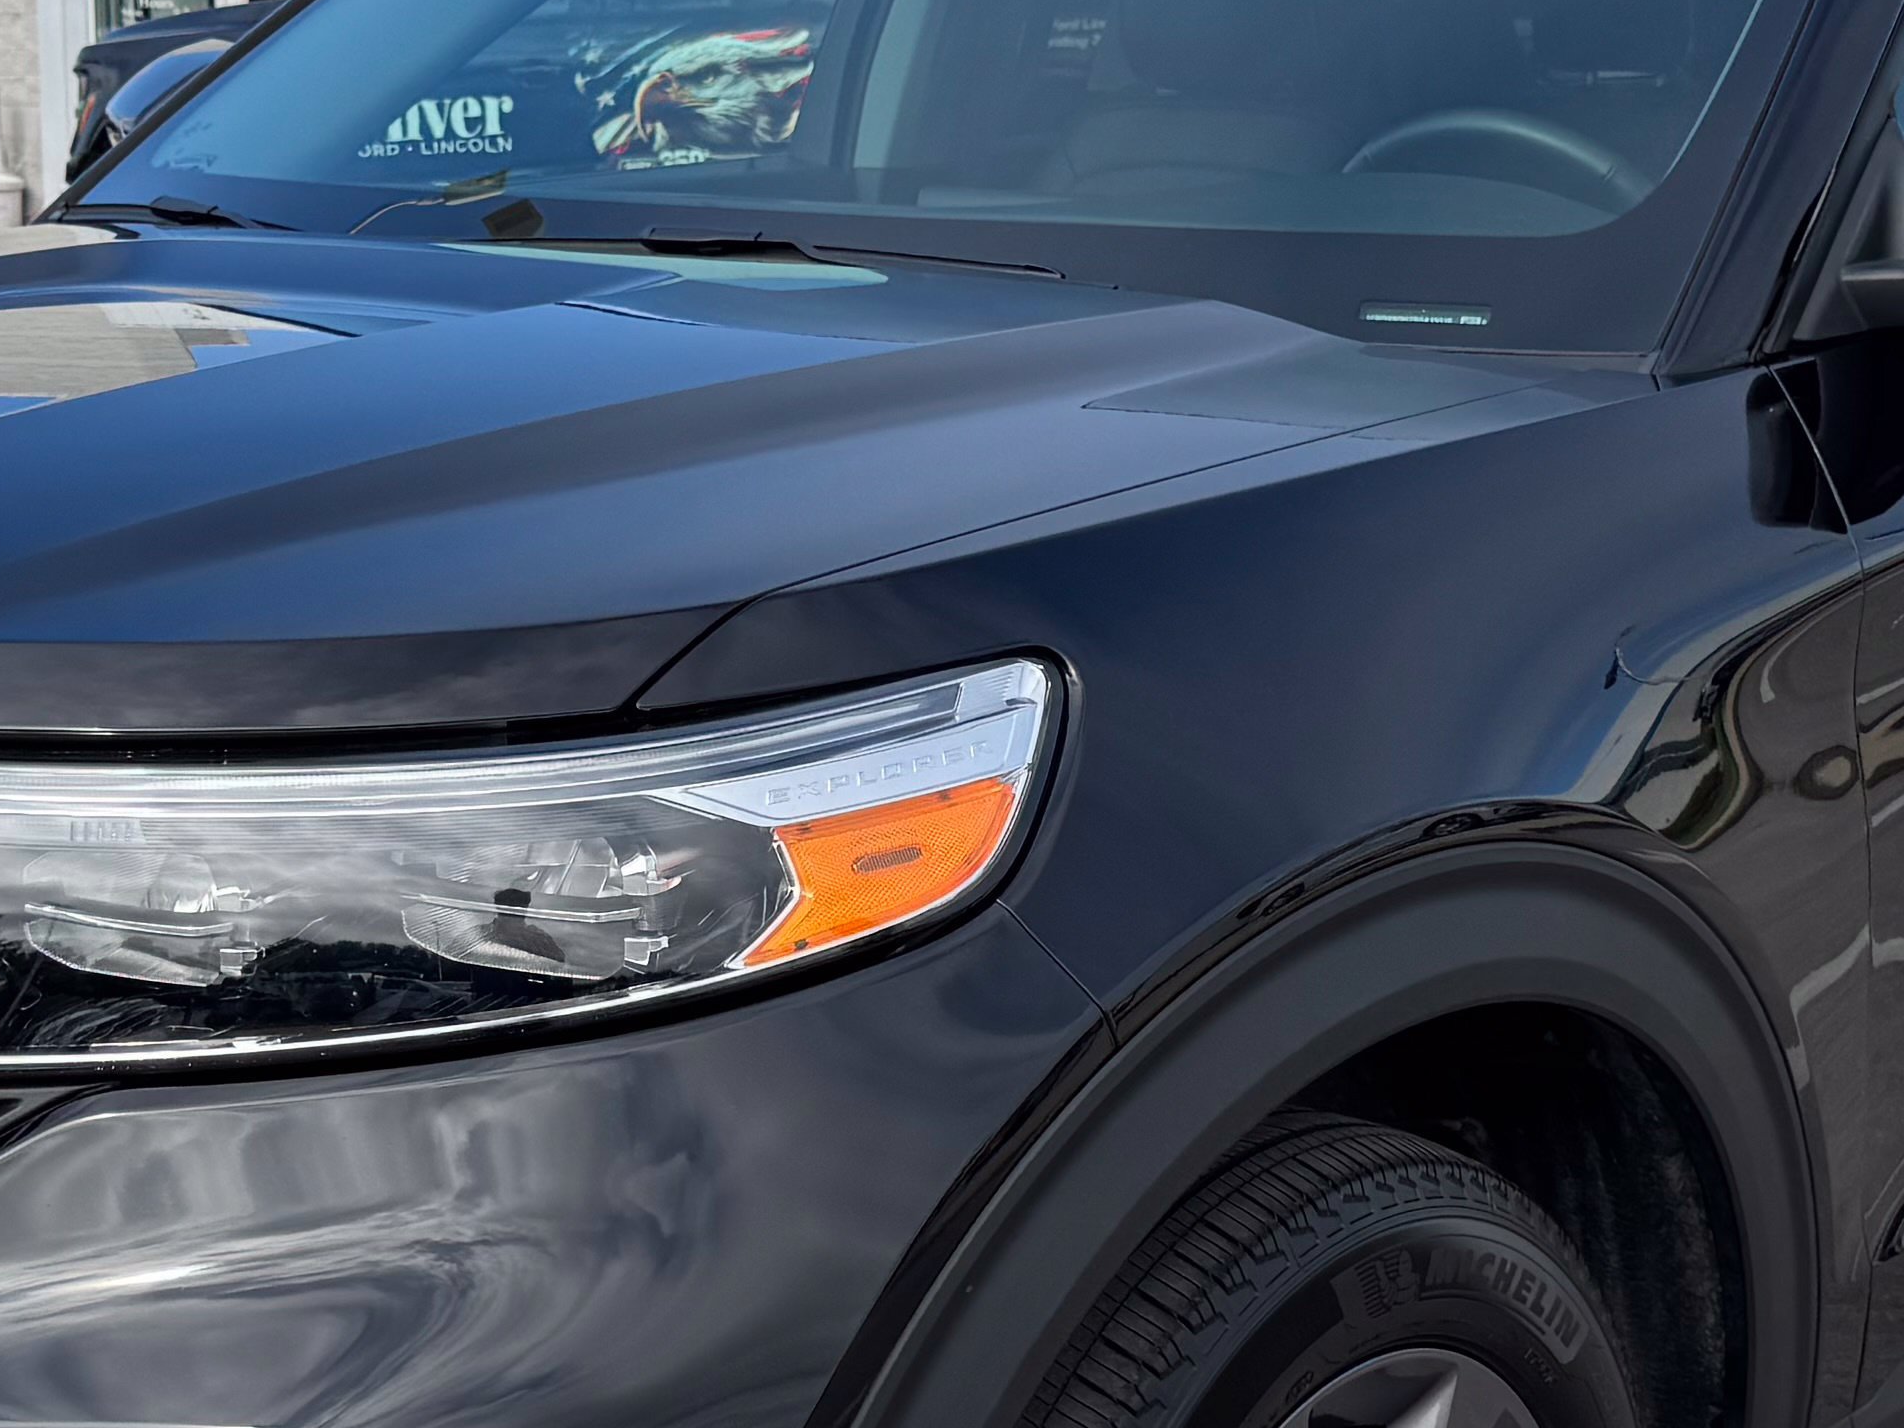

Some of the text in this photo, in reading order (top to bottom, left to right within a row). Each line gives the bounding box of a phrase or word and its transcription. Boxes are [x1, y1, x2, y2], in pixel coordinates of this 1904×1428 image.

[419, 136, 513, 156] LINCOLN
[764, 739, 995, 808] EXPLORER
[1424, 1248, 1584, 1349] MICHELIN
